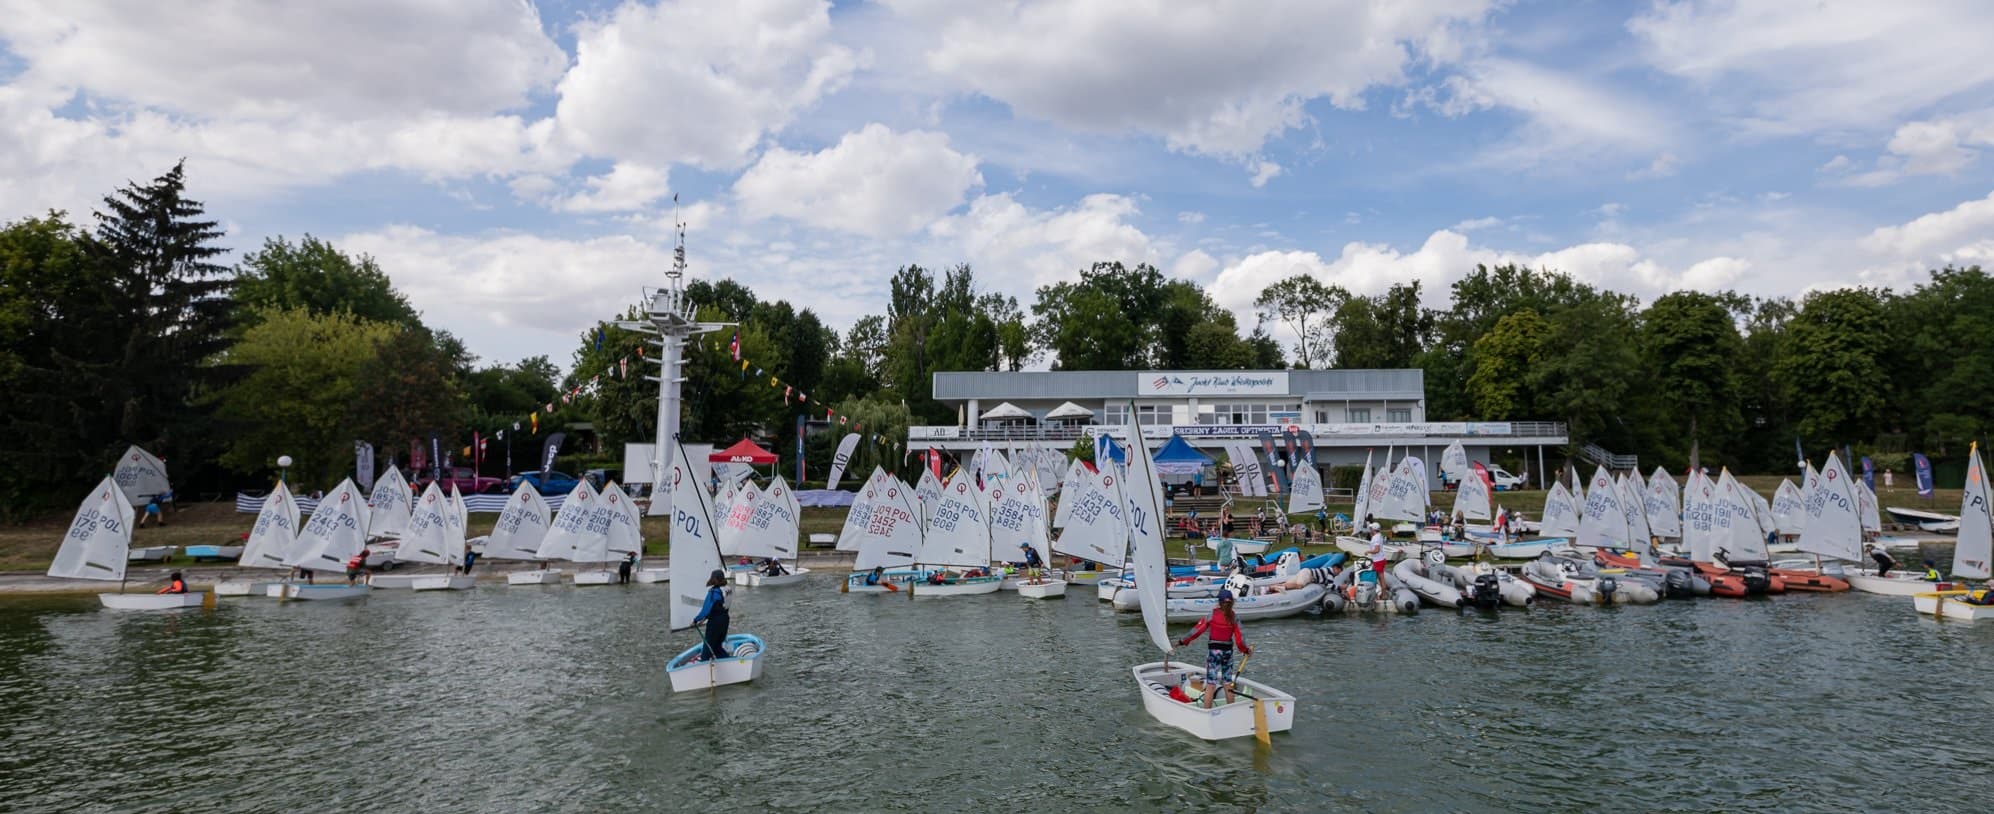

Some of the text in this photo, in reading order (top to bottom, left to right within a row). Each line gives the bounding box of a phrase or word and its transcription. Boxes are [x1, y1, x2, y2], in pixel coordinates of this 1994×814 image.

[1081, 496, 1102, 517] 1433
[1103, 500, 1121, 521] POL
[1830, 493, 1850, 513] POL
[272, 513, 290, 530] POL
[337, 512, 357, 530] POL
[428, 512, 444, 528] POL
[523, 510, 542, 525] POL
[590, 514, 612, 527] 2108
[612, 513, 631, 526] POL
[774, 506, 791, 522] POL
[871, 514, 897, 528] 3452
[891, 508, 912, 524] POL
[936, 506, 960, 522] 1909
[961, 506, 979, 522] POL
[999, 506, 1024, 522] 3584
[677, 509, 702, 538] POL
